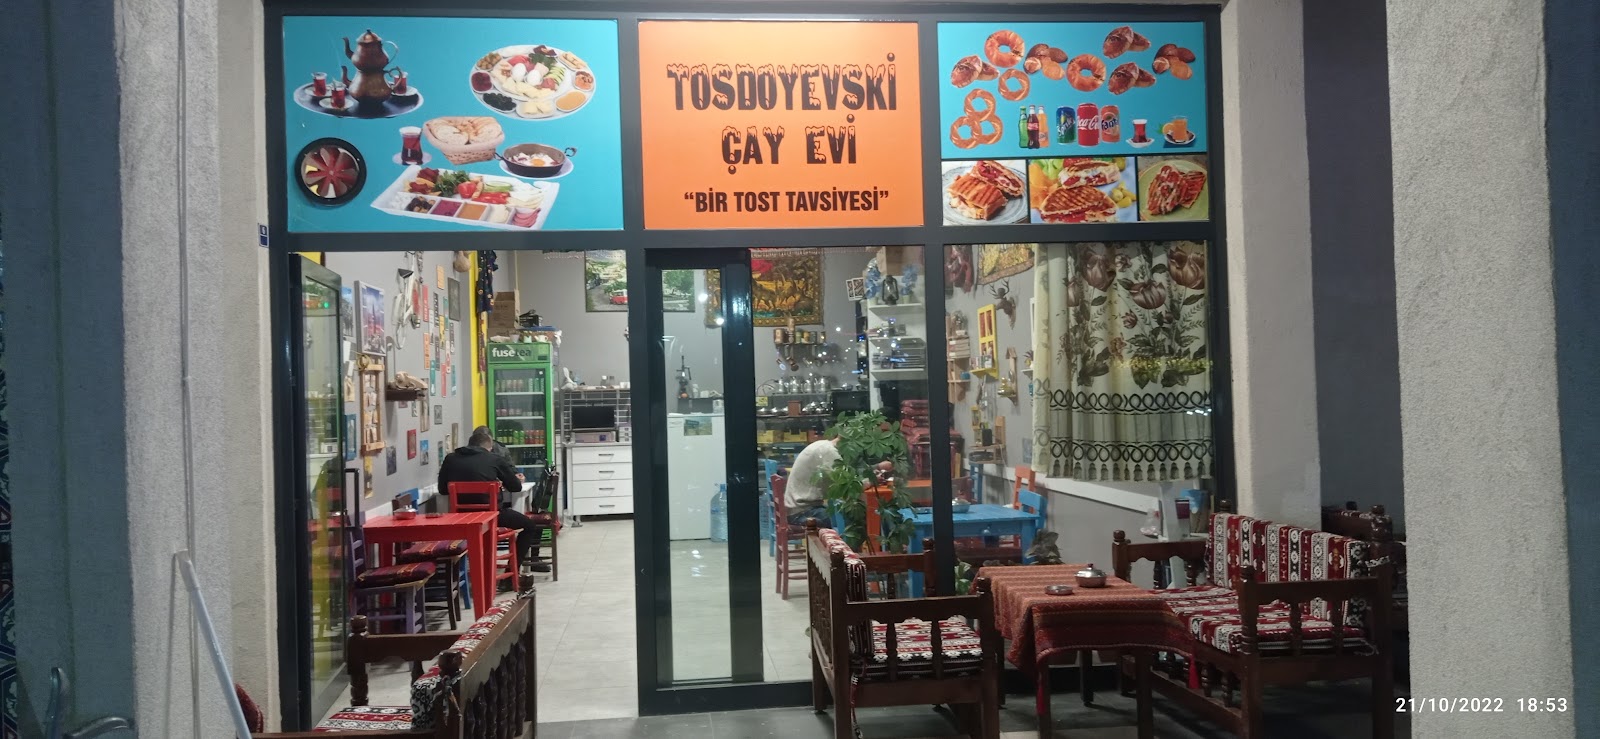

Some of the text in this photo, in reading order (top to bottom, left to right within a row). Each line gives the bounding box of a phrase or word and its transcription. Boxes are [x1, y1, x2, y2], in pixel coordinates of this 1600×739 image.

[666, 52, 896, 111] TOSDOYEVSKİ
[721, 114, 857, 175] ÇAY EVİ
[684, 186, 889, 213] “BİR TOST TAVSİYESİ”
